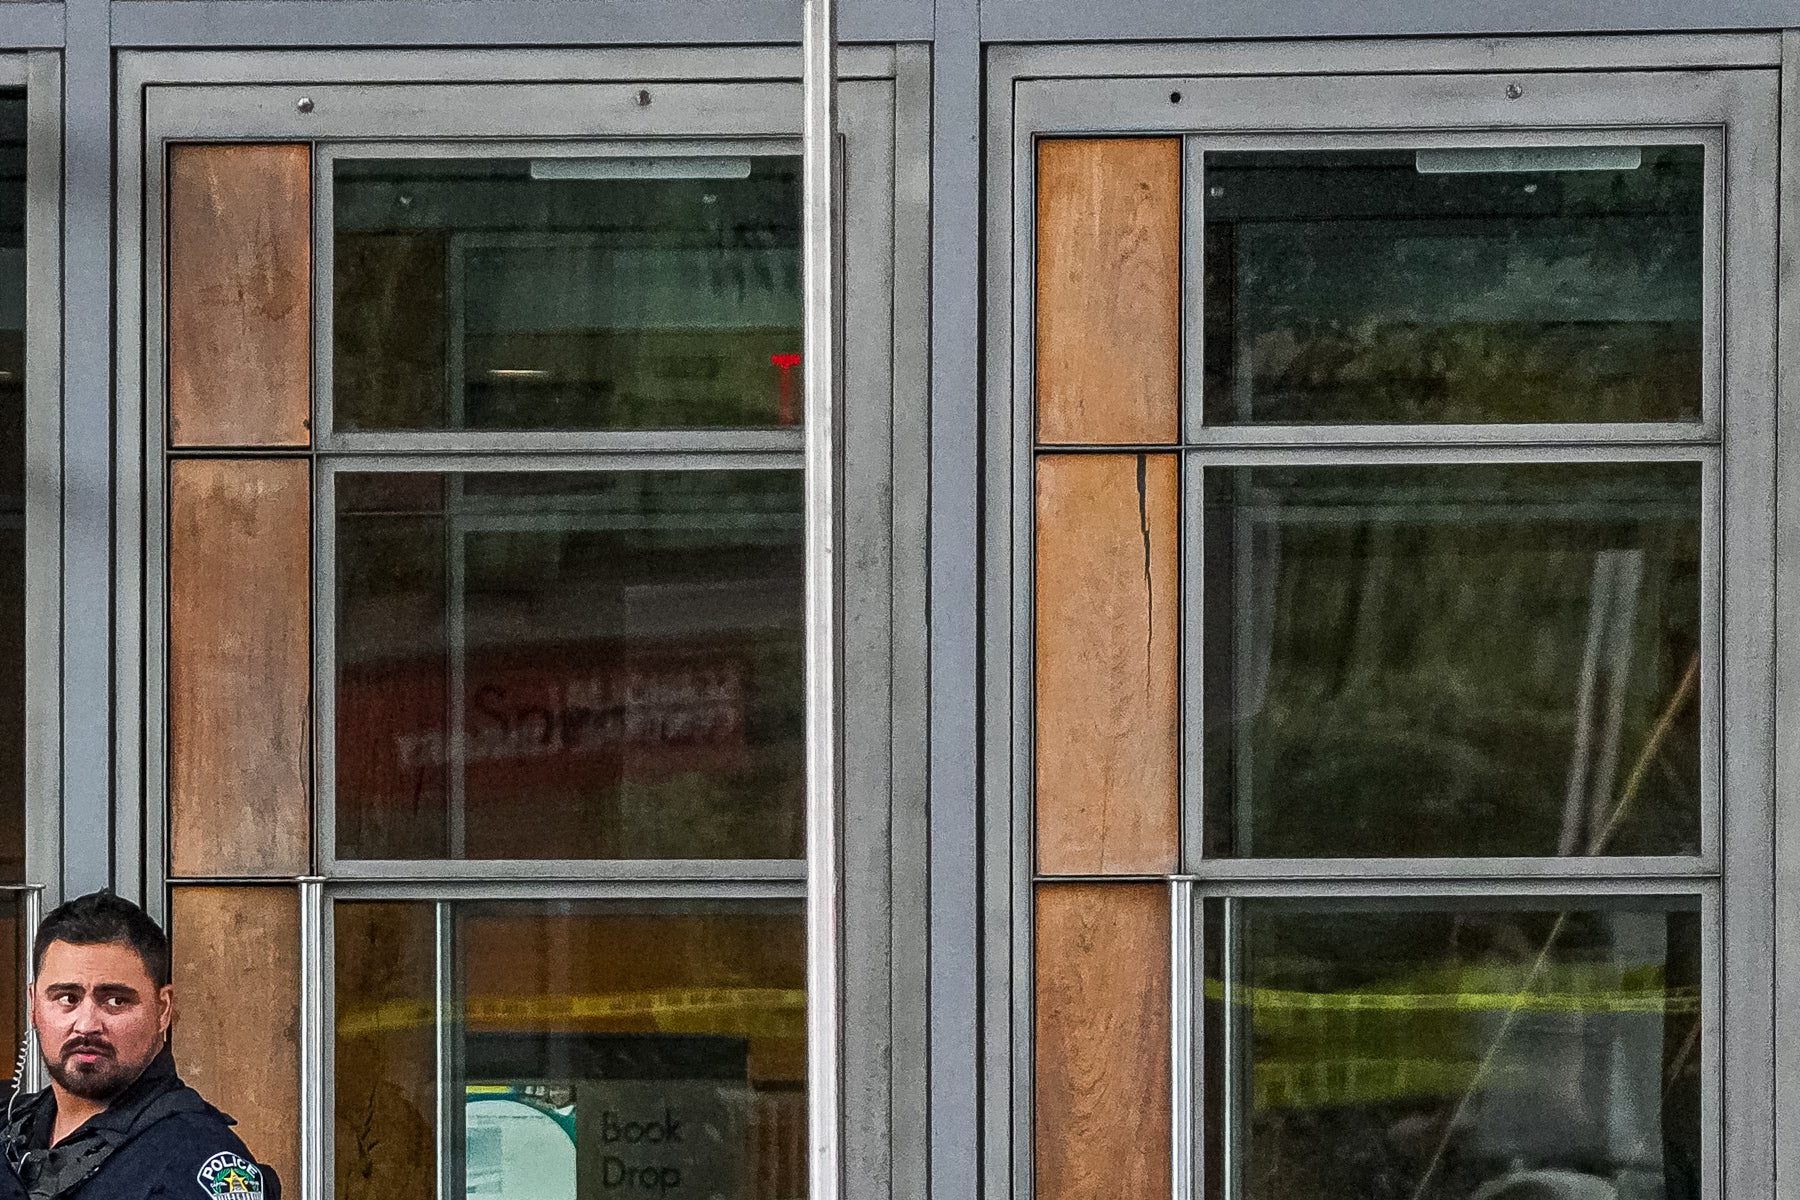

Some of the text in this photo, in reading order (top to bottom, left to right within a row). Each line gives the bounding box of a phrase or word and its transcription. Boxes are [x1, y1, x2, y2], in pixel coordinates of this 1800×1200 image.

[602, 1107, 685, 1144] Book
[202, 1155, 258, 1181] POLICE
[603, 1155, 681, 1197] Drop
